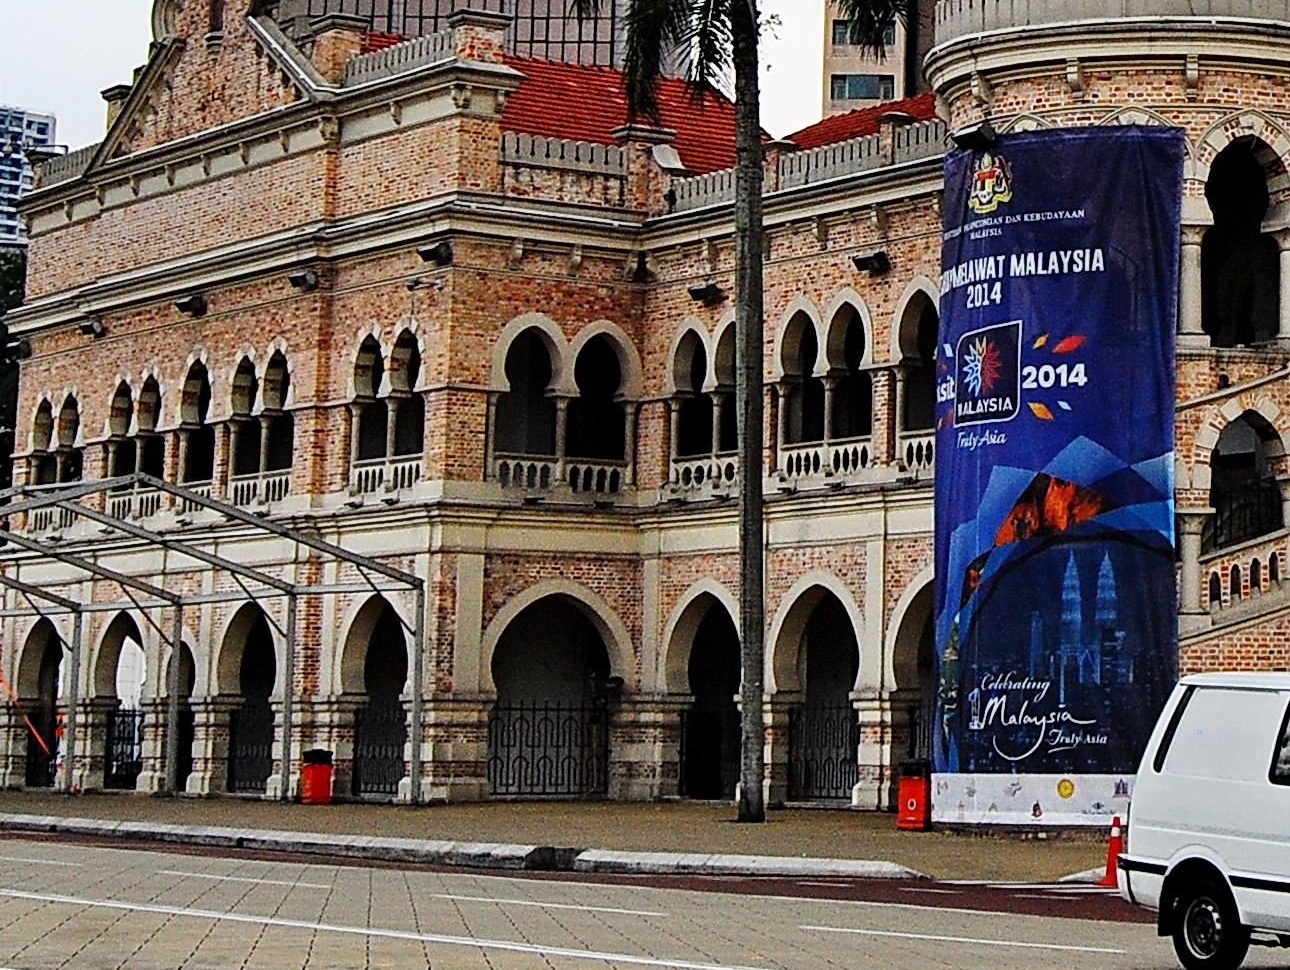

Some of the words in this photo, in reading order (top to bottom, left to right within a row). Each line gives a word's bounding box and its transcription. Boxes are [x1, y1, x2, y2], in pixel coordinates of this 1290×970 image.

[1023, 209, 1085, 222] KEBUDAYAAN
[1009, 248, 1105, 277] MALAYSIA
[966, 281, 1002, 309] 2014
[1022, 362, 1088, 390] 2014
[957, 396, 1013, 417] MALAYSIA
[956, 431, 979, 451] Truly
[978, 429, 1007, 447] Asia
[980, 670, 1051, 703] Celebrating
[1048, 728, 1083, 753] Truly
[1084, 733, 1108, 745] Asia
